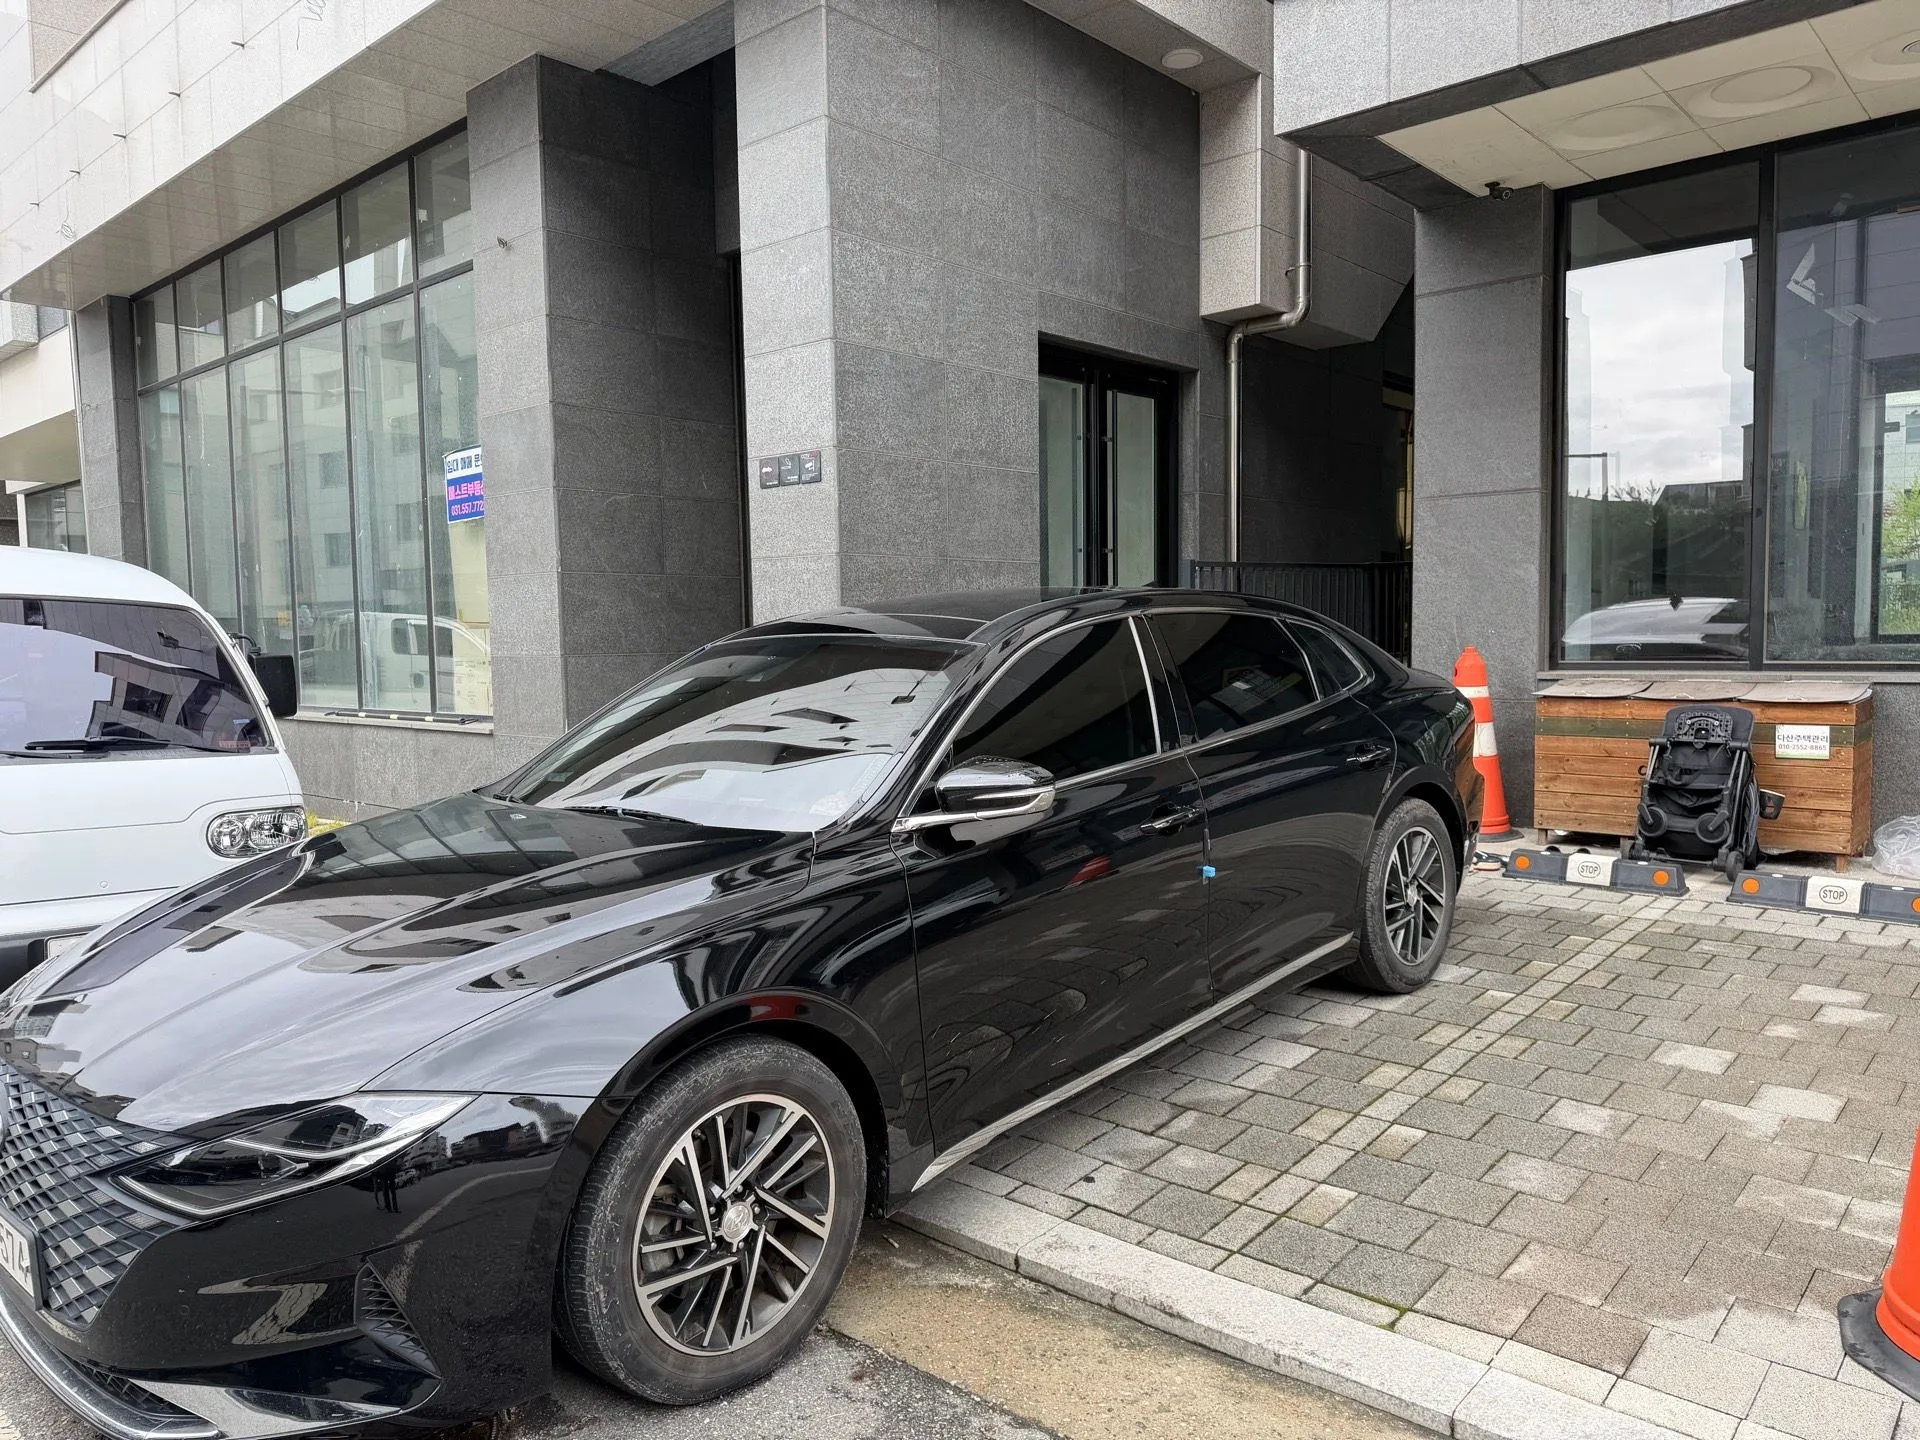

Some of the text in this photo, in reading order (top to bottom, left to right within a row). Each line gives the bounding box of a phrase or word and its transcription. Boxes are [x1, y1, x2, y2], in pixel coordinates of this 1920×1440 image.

[474, 453, 482, 468] 문
[1777, 734, 1829, 743] 다산주택관리
[1580, 864, 1599, 875] STOP
[1822, 889, 1845, 900] STOP
